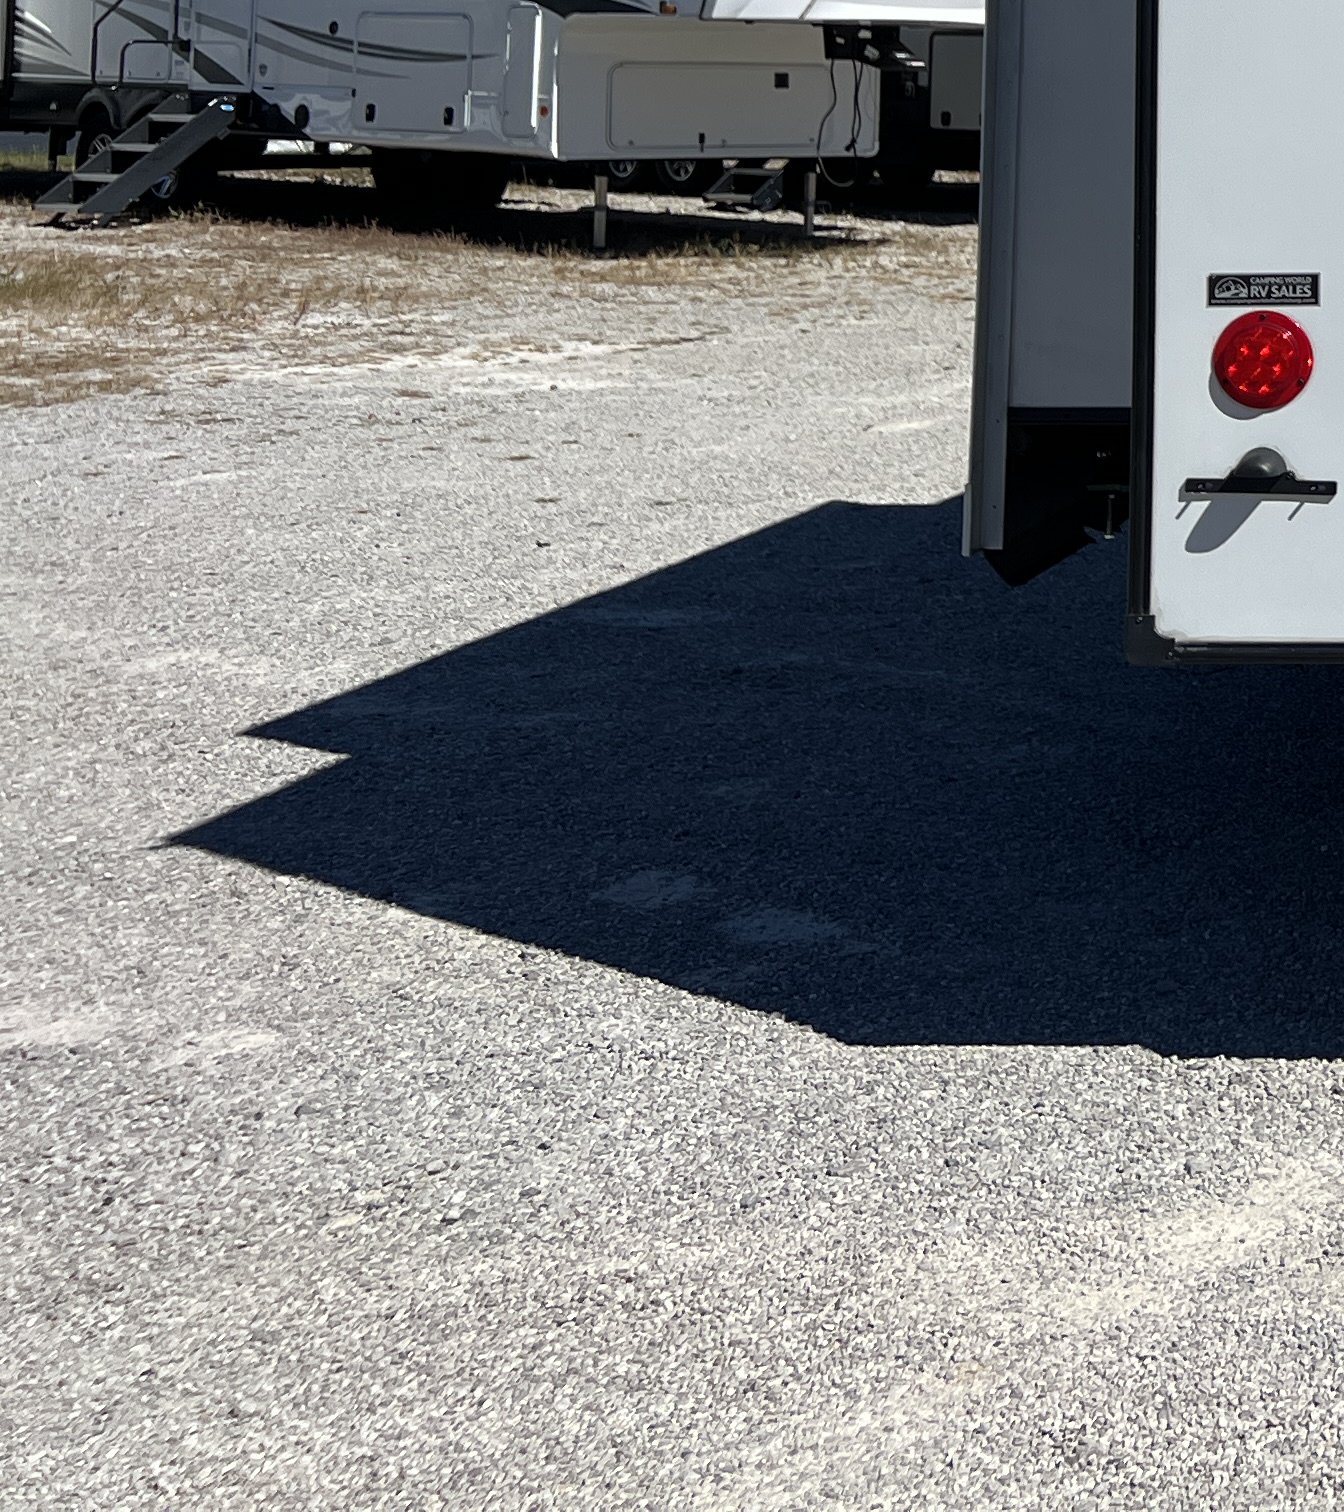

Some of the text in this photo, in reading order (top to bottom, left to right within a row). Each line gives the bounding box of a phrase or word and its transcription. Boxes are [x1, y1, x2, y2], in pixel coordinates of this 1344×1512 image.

[1249, 276, 1312, 285] CAMPING WORLD
[1249, 284, 1312, 298] RV SALES
